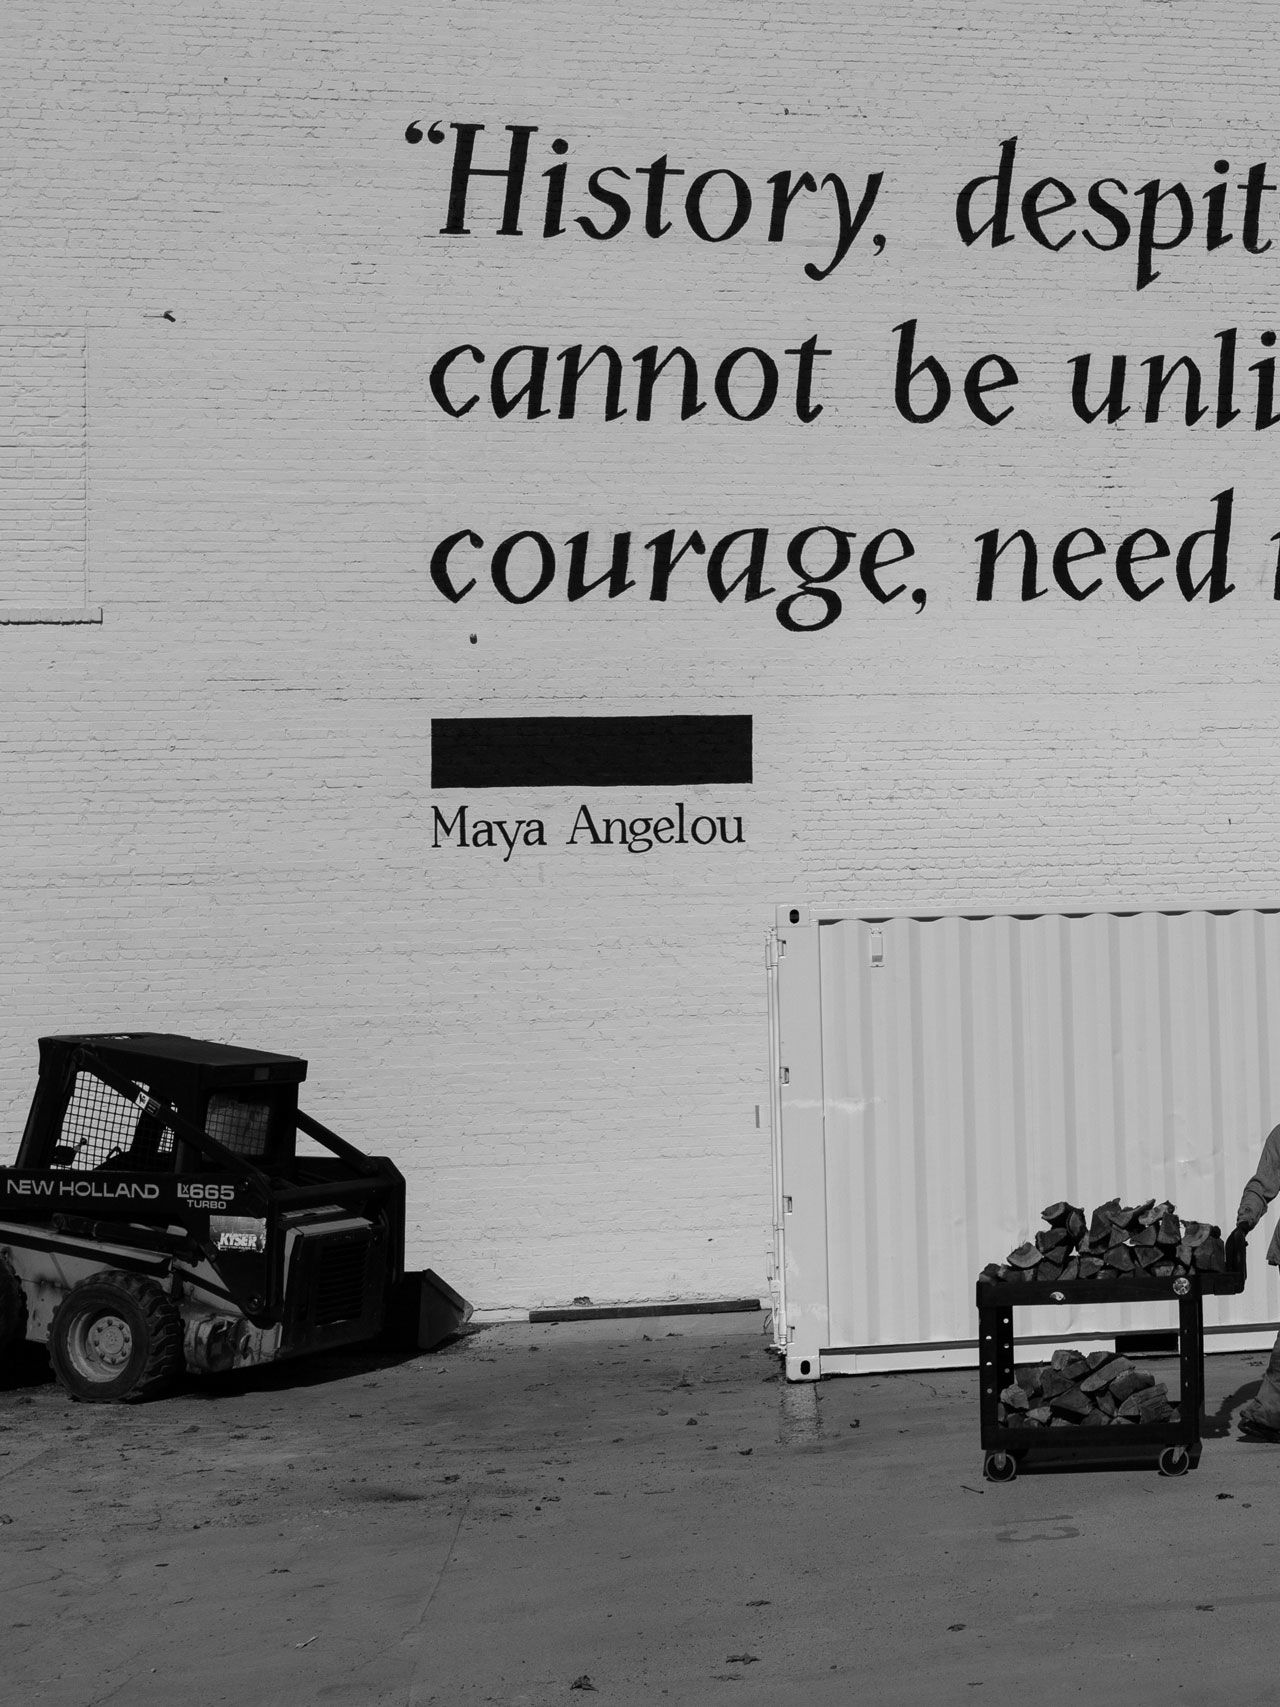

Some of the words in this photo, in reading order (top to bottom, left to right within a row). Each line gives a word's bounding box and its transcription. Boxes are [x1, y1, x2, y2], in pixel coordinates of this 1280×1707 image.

[405, 120, 885, 283] “History,
[429, 333, 833, 425] cannot
[891, 318, 1019, 427] be
[429, 528, 927, 632] courage,
[974, 486, 1237, 605] need
[430, 804, 548, 863] Maya
[564, 803, 747, 854] Angelou
[6, 1179, 55, 1196] NEW
[59, 1181, 161, 1199] HOLLAND
[187, 1199, 227, 1209] TURBO
[219, 1232, 258, 1247] KYSER
